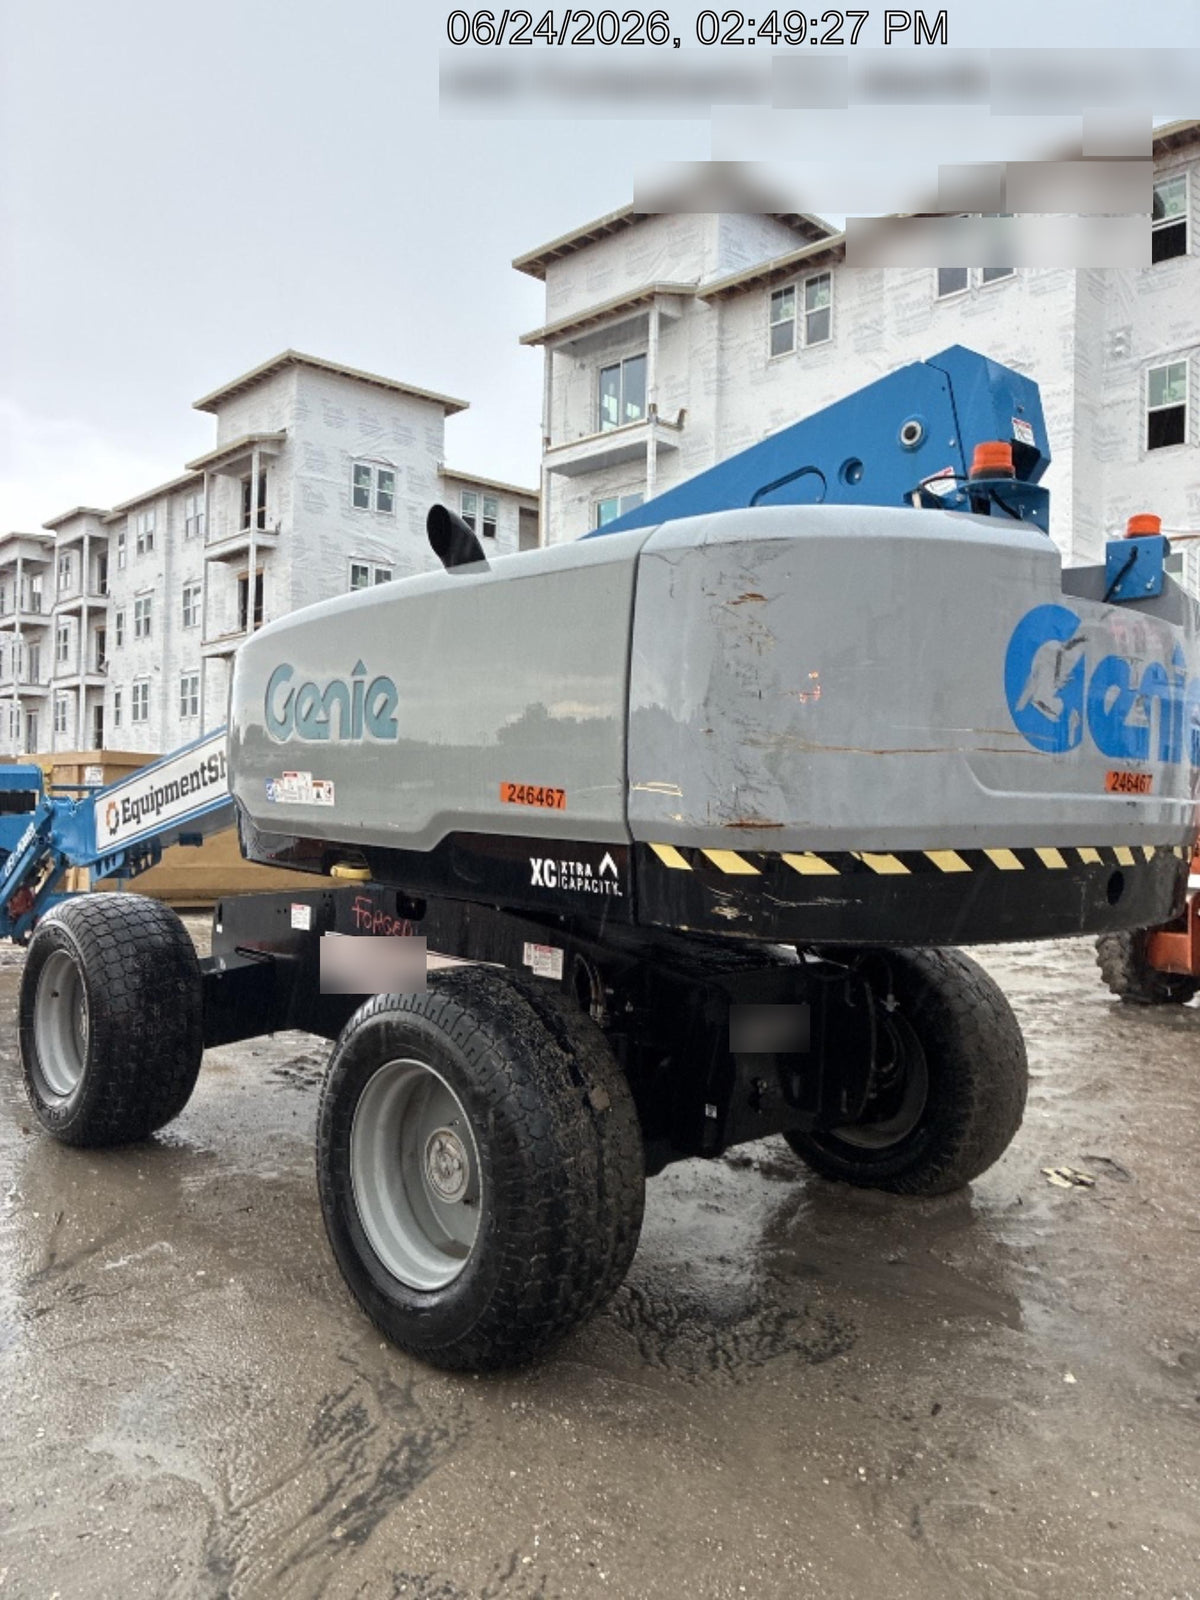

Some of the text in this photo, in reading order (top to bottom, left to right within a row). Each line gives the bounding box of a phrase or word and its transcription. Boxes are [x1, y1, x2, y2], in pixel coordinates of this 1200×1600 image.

[264, 658, 399, 744] Genie
[1110, 771, 1154, 793] 246467
[507, 783, 566, 809] 246467
[529, 857, 557, 888] XC
[561, 861, 593, 877] XTRA
[561, 876, 619, 895] CAPACITY
